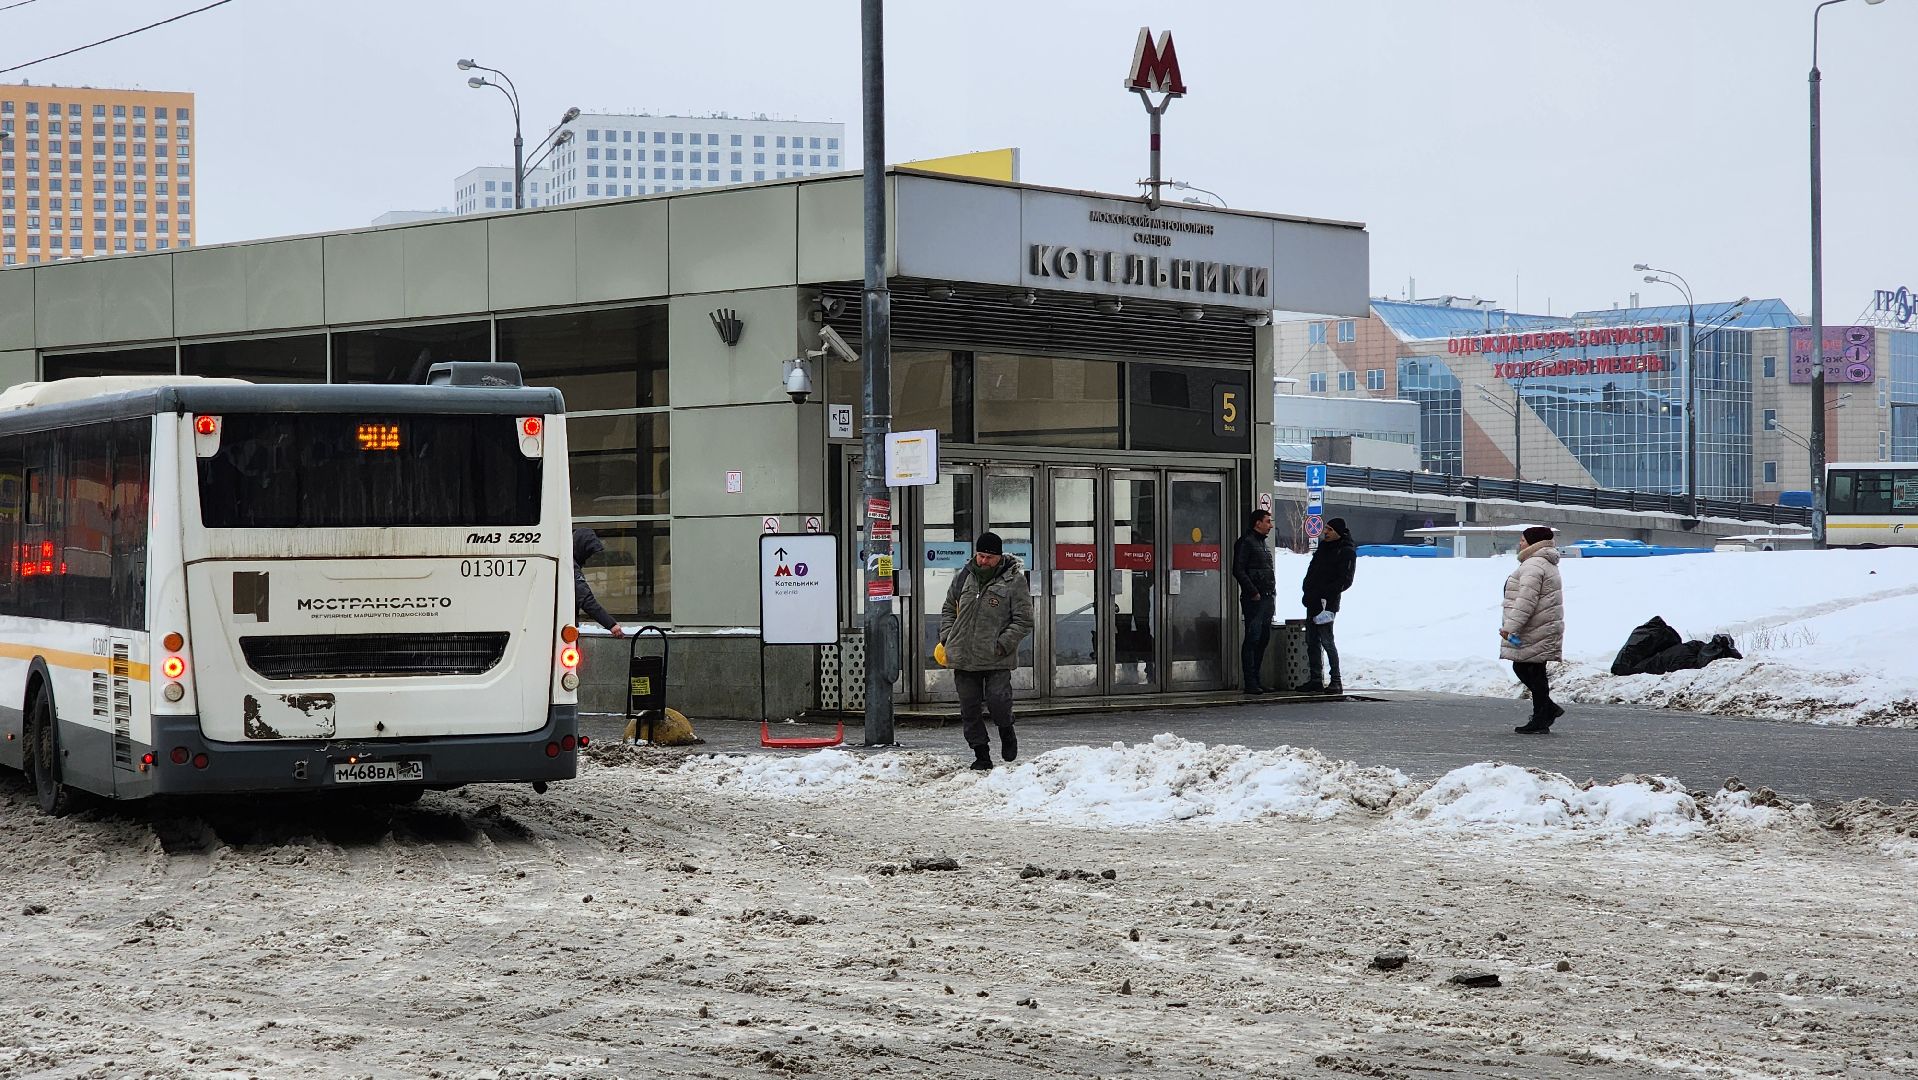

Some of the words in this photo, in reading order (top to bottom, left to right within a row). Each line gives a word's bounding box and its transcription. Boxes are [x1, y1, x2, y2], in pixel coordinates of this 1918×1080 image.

[1124, 26, 1187, 94] М
[1089, 211, 1151, 227] МОСКОВСКИЙ
[1151, 219, 1214, 235] МЕТРОПОЛИТЕН
[1134, 232, 1171, 246] СТАНЦИЯ
[1030, 244, 1269, 297] КОТЕЛЬНИКИ
[1448, 336, 1521, 356] ОДЕЖДА
[1521, 331, 1575, 350] ОБУВЬ
[1578, 326, 1664, 346] ЗАПЧАСТИ
[1597, 354, 1663, 374] МЕБЕЛЬ
[1795, 354, 1809, 363] 2й
[1223, 393, 1236, 422] 5
[466, 533, 501, 543] ЛиАЗ
[508, 533, 541, 543] 5292
[461, 560, 526, 577] 013017
[297, 597, 452, 610] МОСТРАНСАВТО
